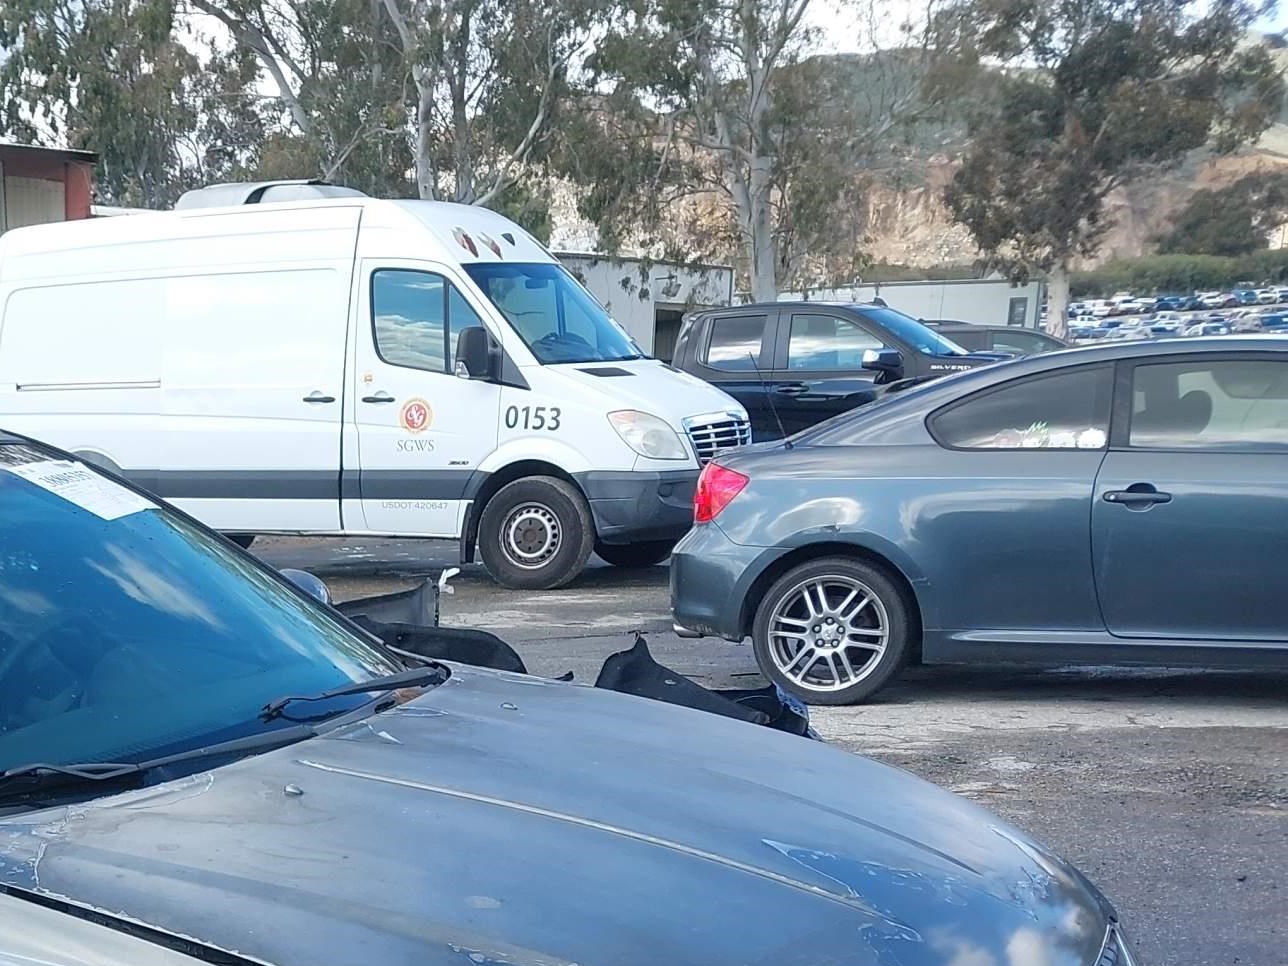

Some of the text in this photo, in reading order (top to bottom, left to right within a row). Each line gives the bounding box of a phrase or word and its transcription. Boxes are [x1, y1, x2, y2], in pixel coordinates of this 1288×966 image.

[505, 405, 561, 431] 0153
[396, 440, 435, 452] SGWS
[382, 501, 448, 510] USDOT 420647
